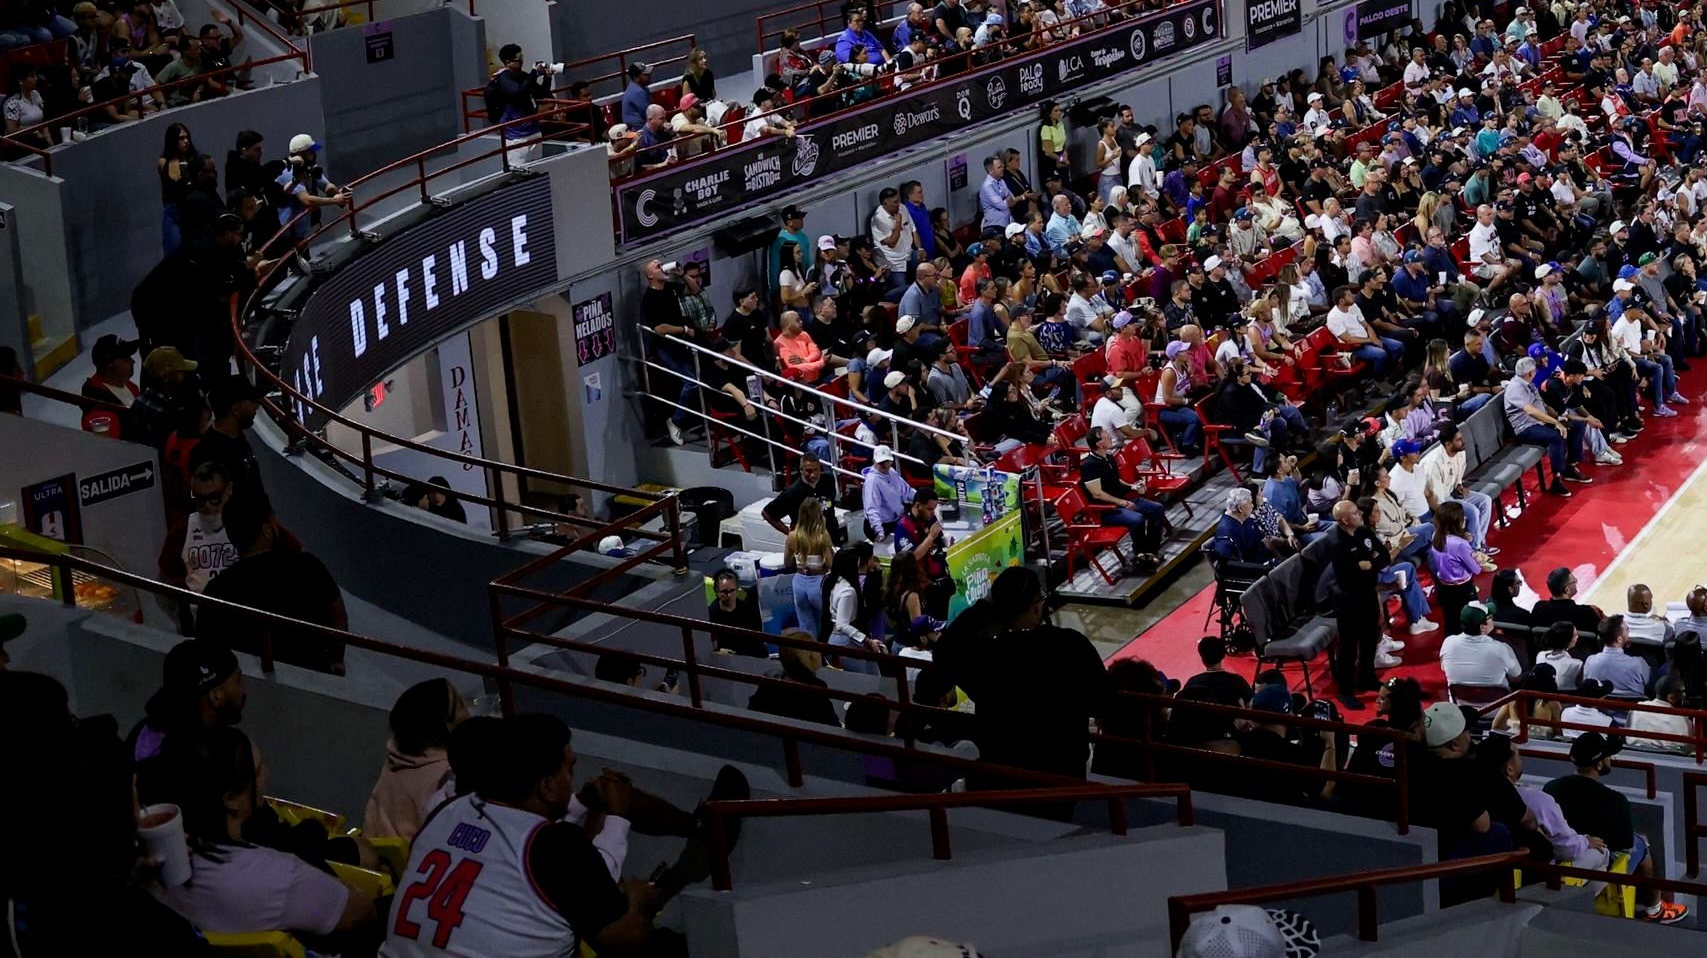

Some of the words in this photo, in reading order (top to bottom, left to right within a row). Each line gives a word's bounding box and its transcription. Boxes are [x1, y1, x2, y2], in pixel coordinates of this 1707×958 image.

[1359, 10, 1384, 27] PALCO
[957, 98, 972, 122] Q
[832, 123, 880, 151] PREMIER
[744, 155, 781, 181] SANDWICH
[751, 170, 775, 191] BISTRO
[685, 170, 730, 194] CHARLIE
[697, 184, 720, 199] BOY
[349, 213, 531, 360] DEFENSE
[583, 299, 603, 321] PIÑA
[575, 313, 613, 340] HELADOS
[449, 365, 475, 472] DAMAS
[33, 485, 63, 502] ULTRA
[80, 473, 131, 499] SALIDA
[394, 848, 484, 949] 24
